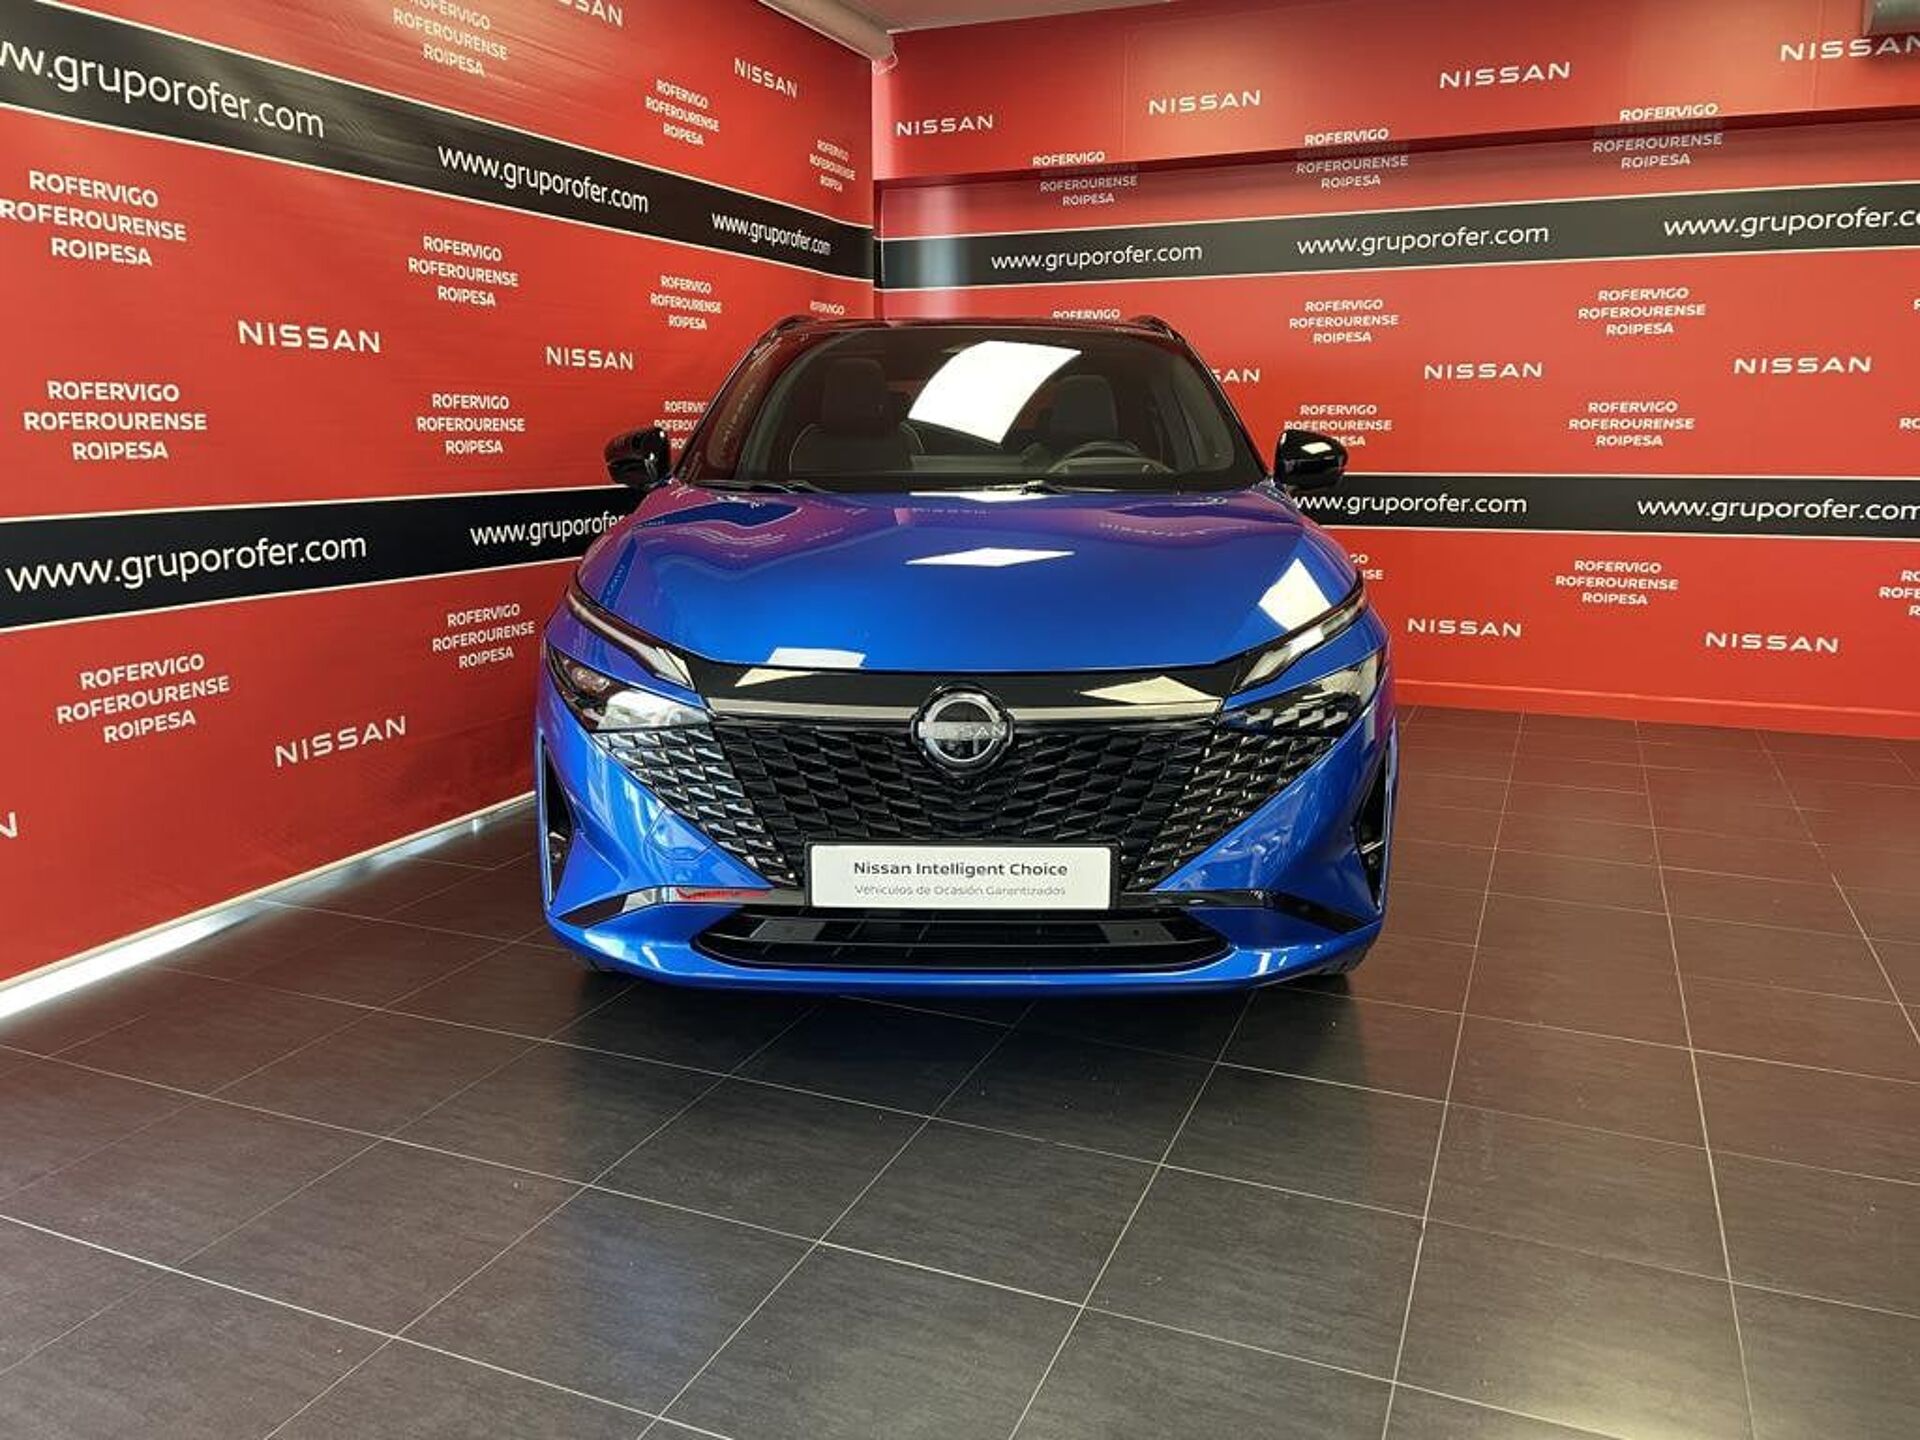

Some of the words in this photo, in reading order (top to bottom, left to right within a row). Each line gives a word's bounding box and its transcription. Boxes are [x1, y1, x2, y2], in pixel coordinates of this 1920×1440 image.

[423, 44, 485, 77] ROIPESA
[734, 57, 798, 98] NISSAN
[1439, 61, 1570, 89] NISSAN
[1148, 89, 1261, 115] NISSAN
[1619, 102, 1721, 122] ROFERVIGO
[895, 114, 993, 137] NISSAN
[1303, 127, 1390, 147] ROFERVIGO
[1032, 150, 1106, 167] ROFERVIGO
[1621, 153, 1691, 169] ROIPESA
[29, 170, 159, 208] ROFERVIGO
[438, 146, 648, 214] www.gruporofer.com
[1321, 174, 1381, 189] ROIPESA
[1062, 192, 1115, 207] ROIPESA
[0, 199, 187, 241] ROFEROURENSE
[51, 237, 153, 266] ROIPESA
[423, 236, 502, 262] ROFERVIGO
[1296, 226, 1549, 257] www.gruporofer.com
[991, 244, 1203, 272] www.gruporofer.com
[409, 258, 518, 287] ROFEROURENSE
[437, 285, 496, 307] ROIPESA
[1597, 287, 1689, 302] ROFERVIGO
[1304, 298, 1384, 313] ROFERVIGO
[1578, 303, 1706, 320] ROFEROURENSE
[1289, 314, 1399, 329] ROFEROURENSE
[1606, 322, 1674, 336] ROIPESA
[237, 320, 380, 353] NISSAN
[1313, 331, 1372, 344] ROIPESA
[546, 346, 633, 370] NISSAN
[1734, 356, 1871, 374] NISSAN
[1424, 362, 1542, 380] NISSAN
[47, 380, 180, 402] ROFERVIGO
[432, 393, 510, 410] ROFERVIGO
[1300, 404, 1378, 416] ROFERVIGO
[1588, 400, 1678, 414] ROFERVIGO
[23, 411, 207, 431] ROFEROURENSE
[416, 416, 526, 432] ROFEROURENSE
[1568, 417, 1695, 430] ROFEROURENSE
[445, 439, 504, 455] ROIPESA
[1595, 434, 1664, 447] ROIPESA
[72, 441, 169, 461] ROIPESA
[6, 537, 367, 590] www.gruporofer.com
[1574, 560, 1662, 574] ROFERVIGO
[1555, 575, 1679, 590] ROFEROURENSE
[1582, 591, 1649, 605] ROIPESA
[447, 604, 521, 627] ROFERVIGO
[433, 622, 535, 652] ROFEROURENSE
[1407, 618, 1522, 638] NISSAN
[1705, 631, 1839, 653] NISSAN
[459, 647, 515, 669] ROIPESA
[80, 654, 205, 689] ROFERVIGO
[57, 676, 230, 724] ROFEROURENSE
[104, 710, 196, 744] ROIPESA
[275, 715, 406, 768] NISSAN
[854, 862, 912, 875] Nissan
[916, 862, 1005, 878] Intelligent
[1010, 862, 1068, 876] Choice
